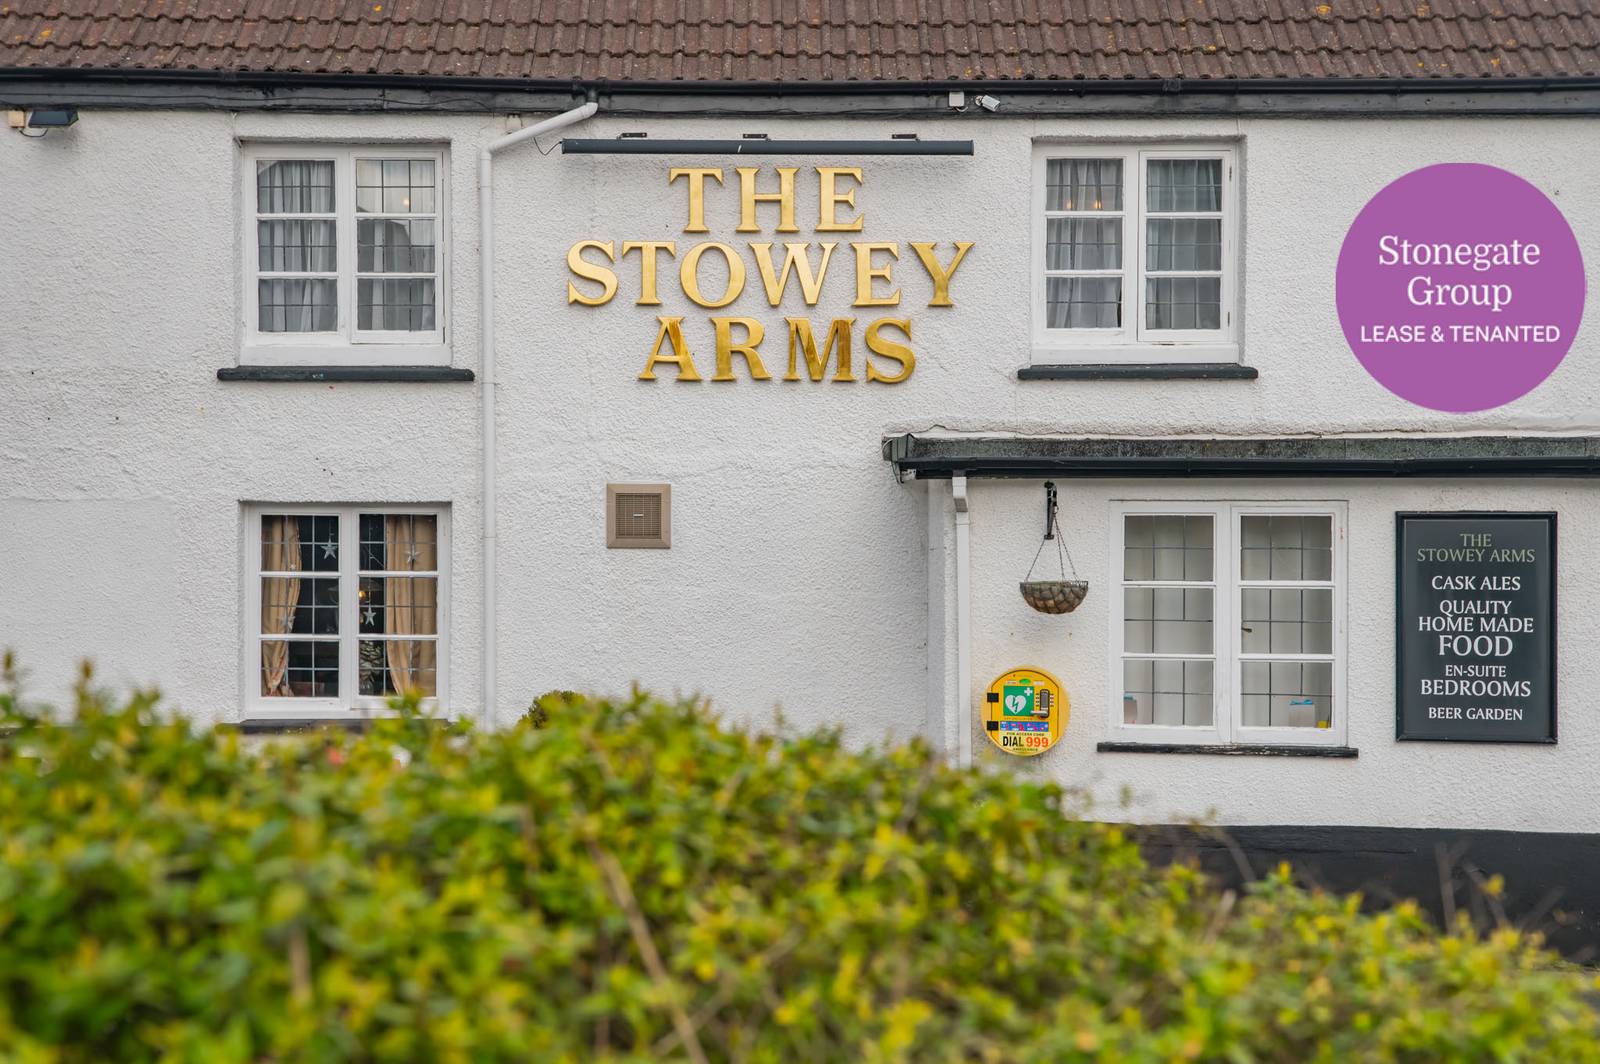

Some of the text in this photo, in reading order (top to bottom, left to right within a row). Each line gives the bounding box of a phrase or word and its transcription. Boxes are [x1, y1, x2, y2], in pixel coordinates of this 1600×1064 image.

[669, 166, 865, 233] THE
[566, 240, 976, 308] STOWEY
[638, 316, 917, 384] ARMS
[1459, 533, 1492, 548] THE
[1416, 548, 1536, 563] STOWEY ARMS
[1431, 575, 1521, 591] CASK ALES
[1439, 599, 1512, 617] QUALITY
[1418, 616, 1534, 633] HOME MADE
[1438, 634, 1513, 657] FOOD
[1445, 664, 1507, 677] EN-SUITE
[1420, 679, 1531, 697] BEDROOMS
[1428, 707, 1523, 721] BEER GARDEN
[1002, 736, 1048, 747] DIAL 999
